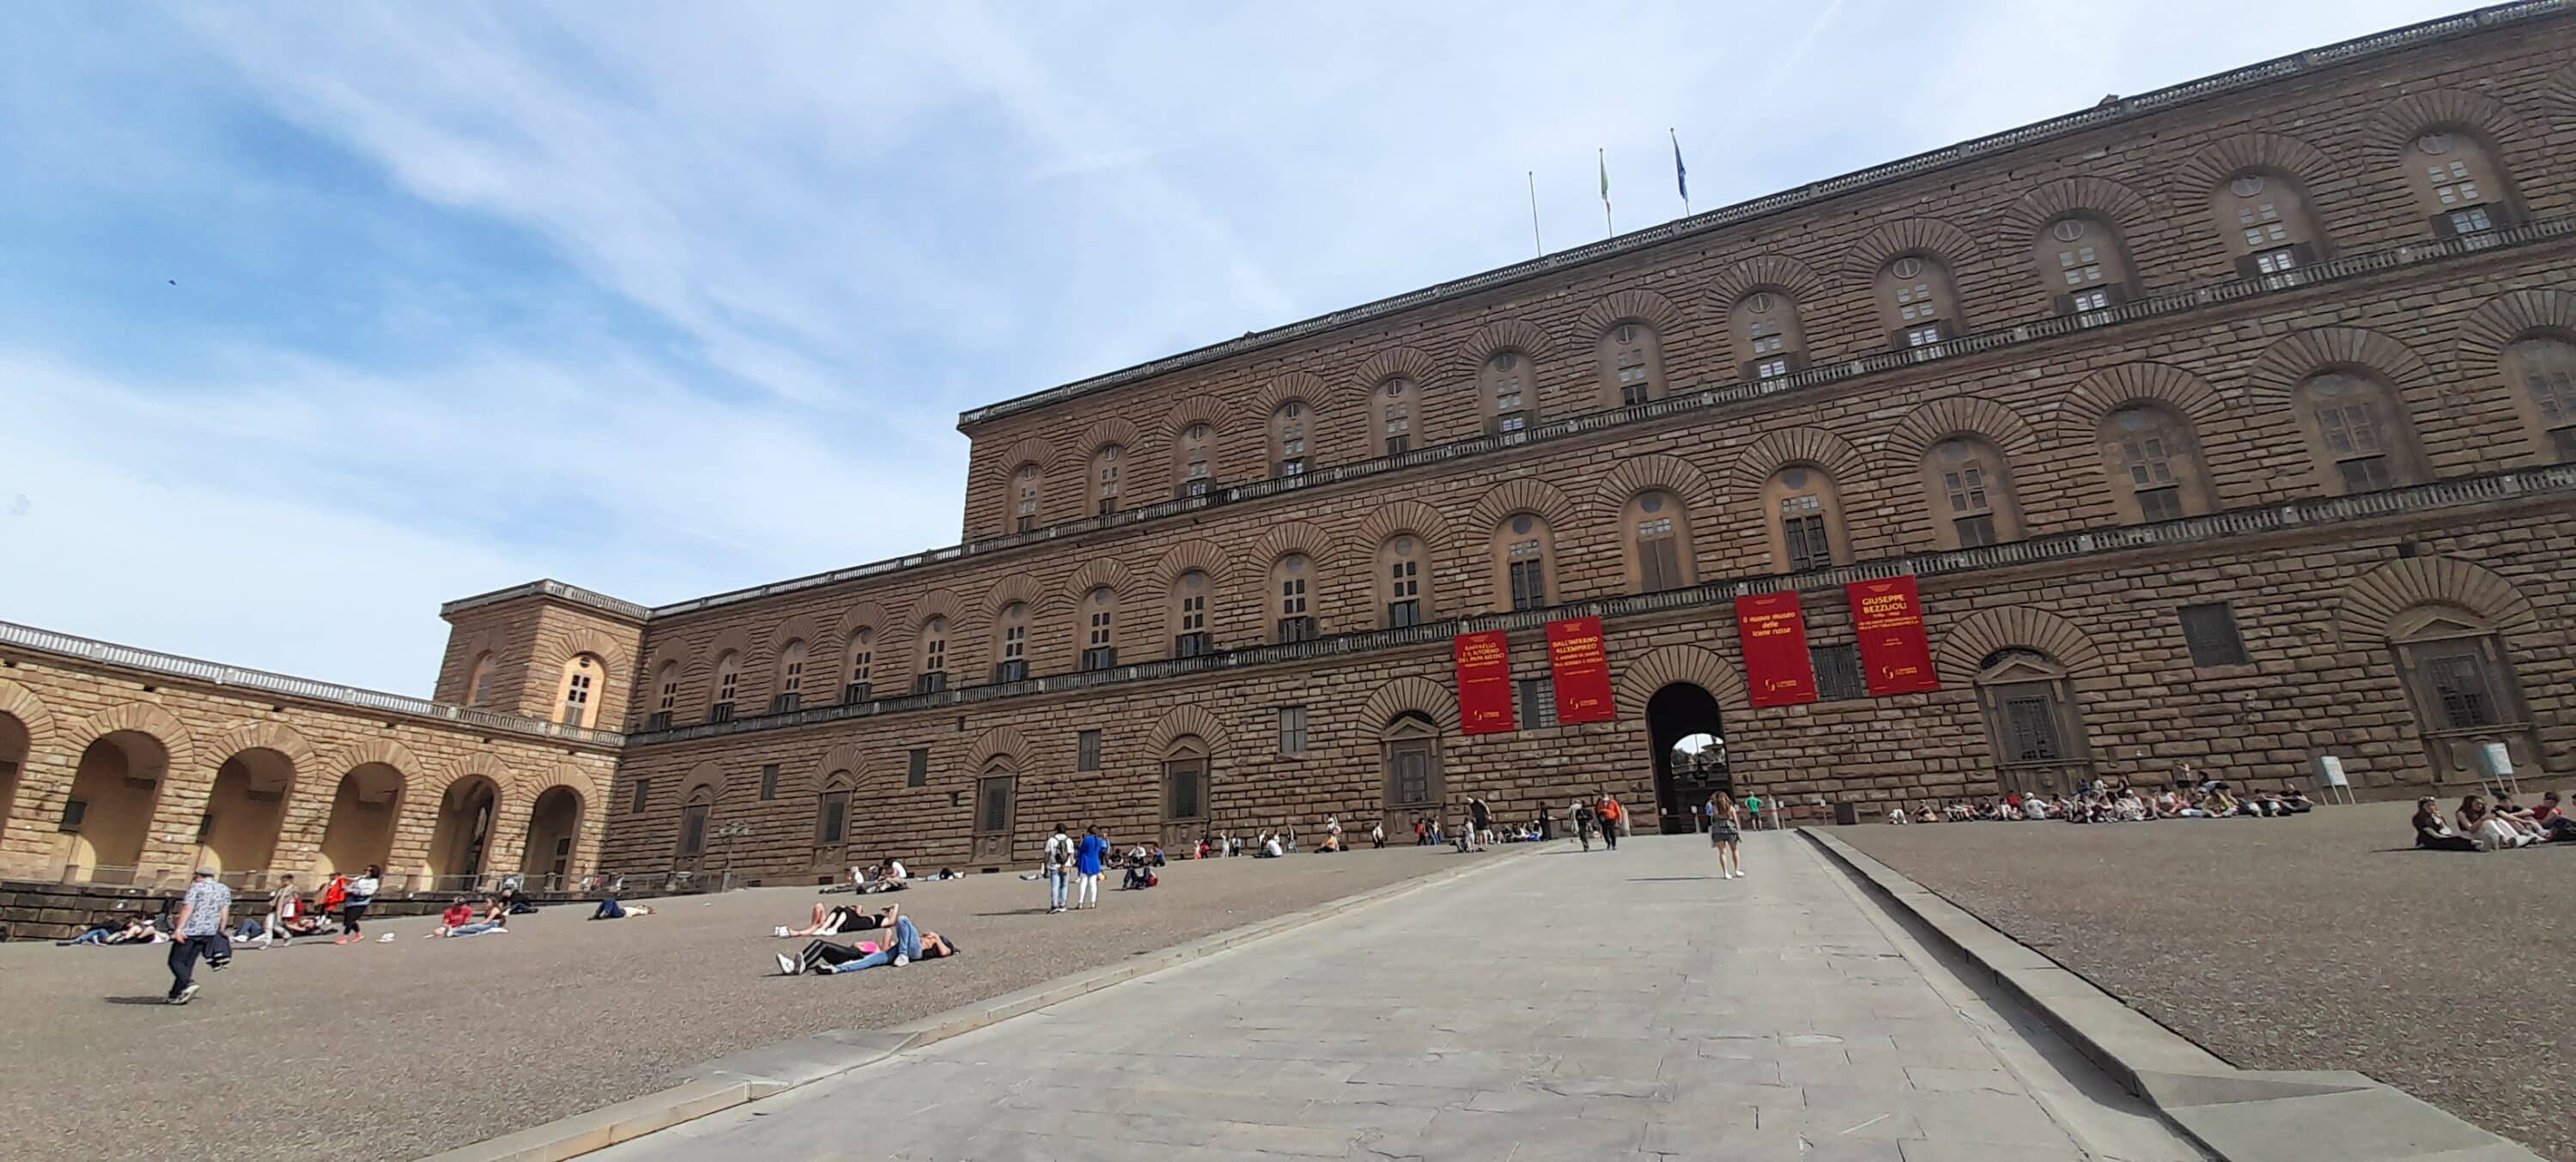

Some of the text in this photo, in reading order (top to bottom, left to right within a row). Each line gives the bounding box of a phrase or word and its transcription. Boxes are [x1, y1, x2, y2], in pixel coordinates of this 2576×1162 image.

[1862, 594, 1905, 605] GIUSEPPE
[1862, 602, 1907, 613] BEZZUOLI
[1762, 620, 1779, 629] delle
